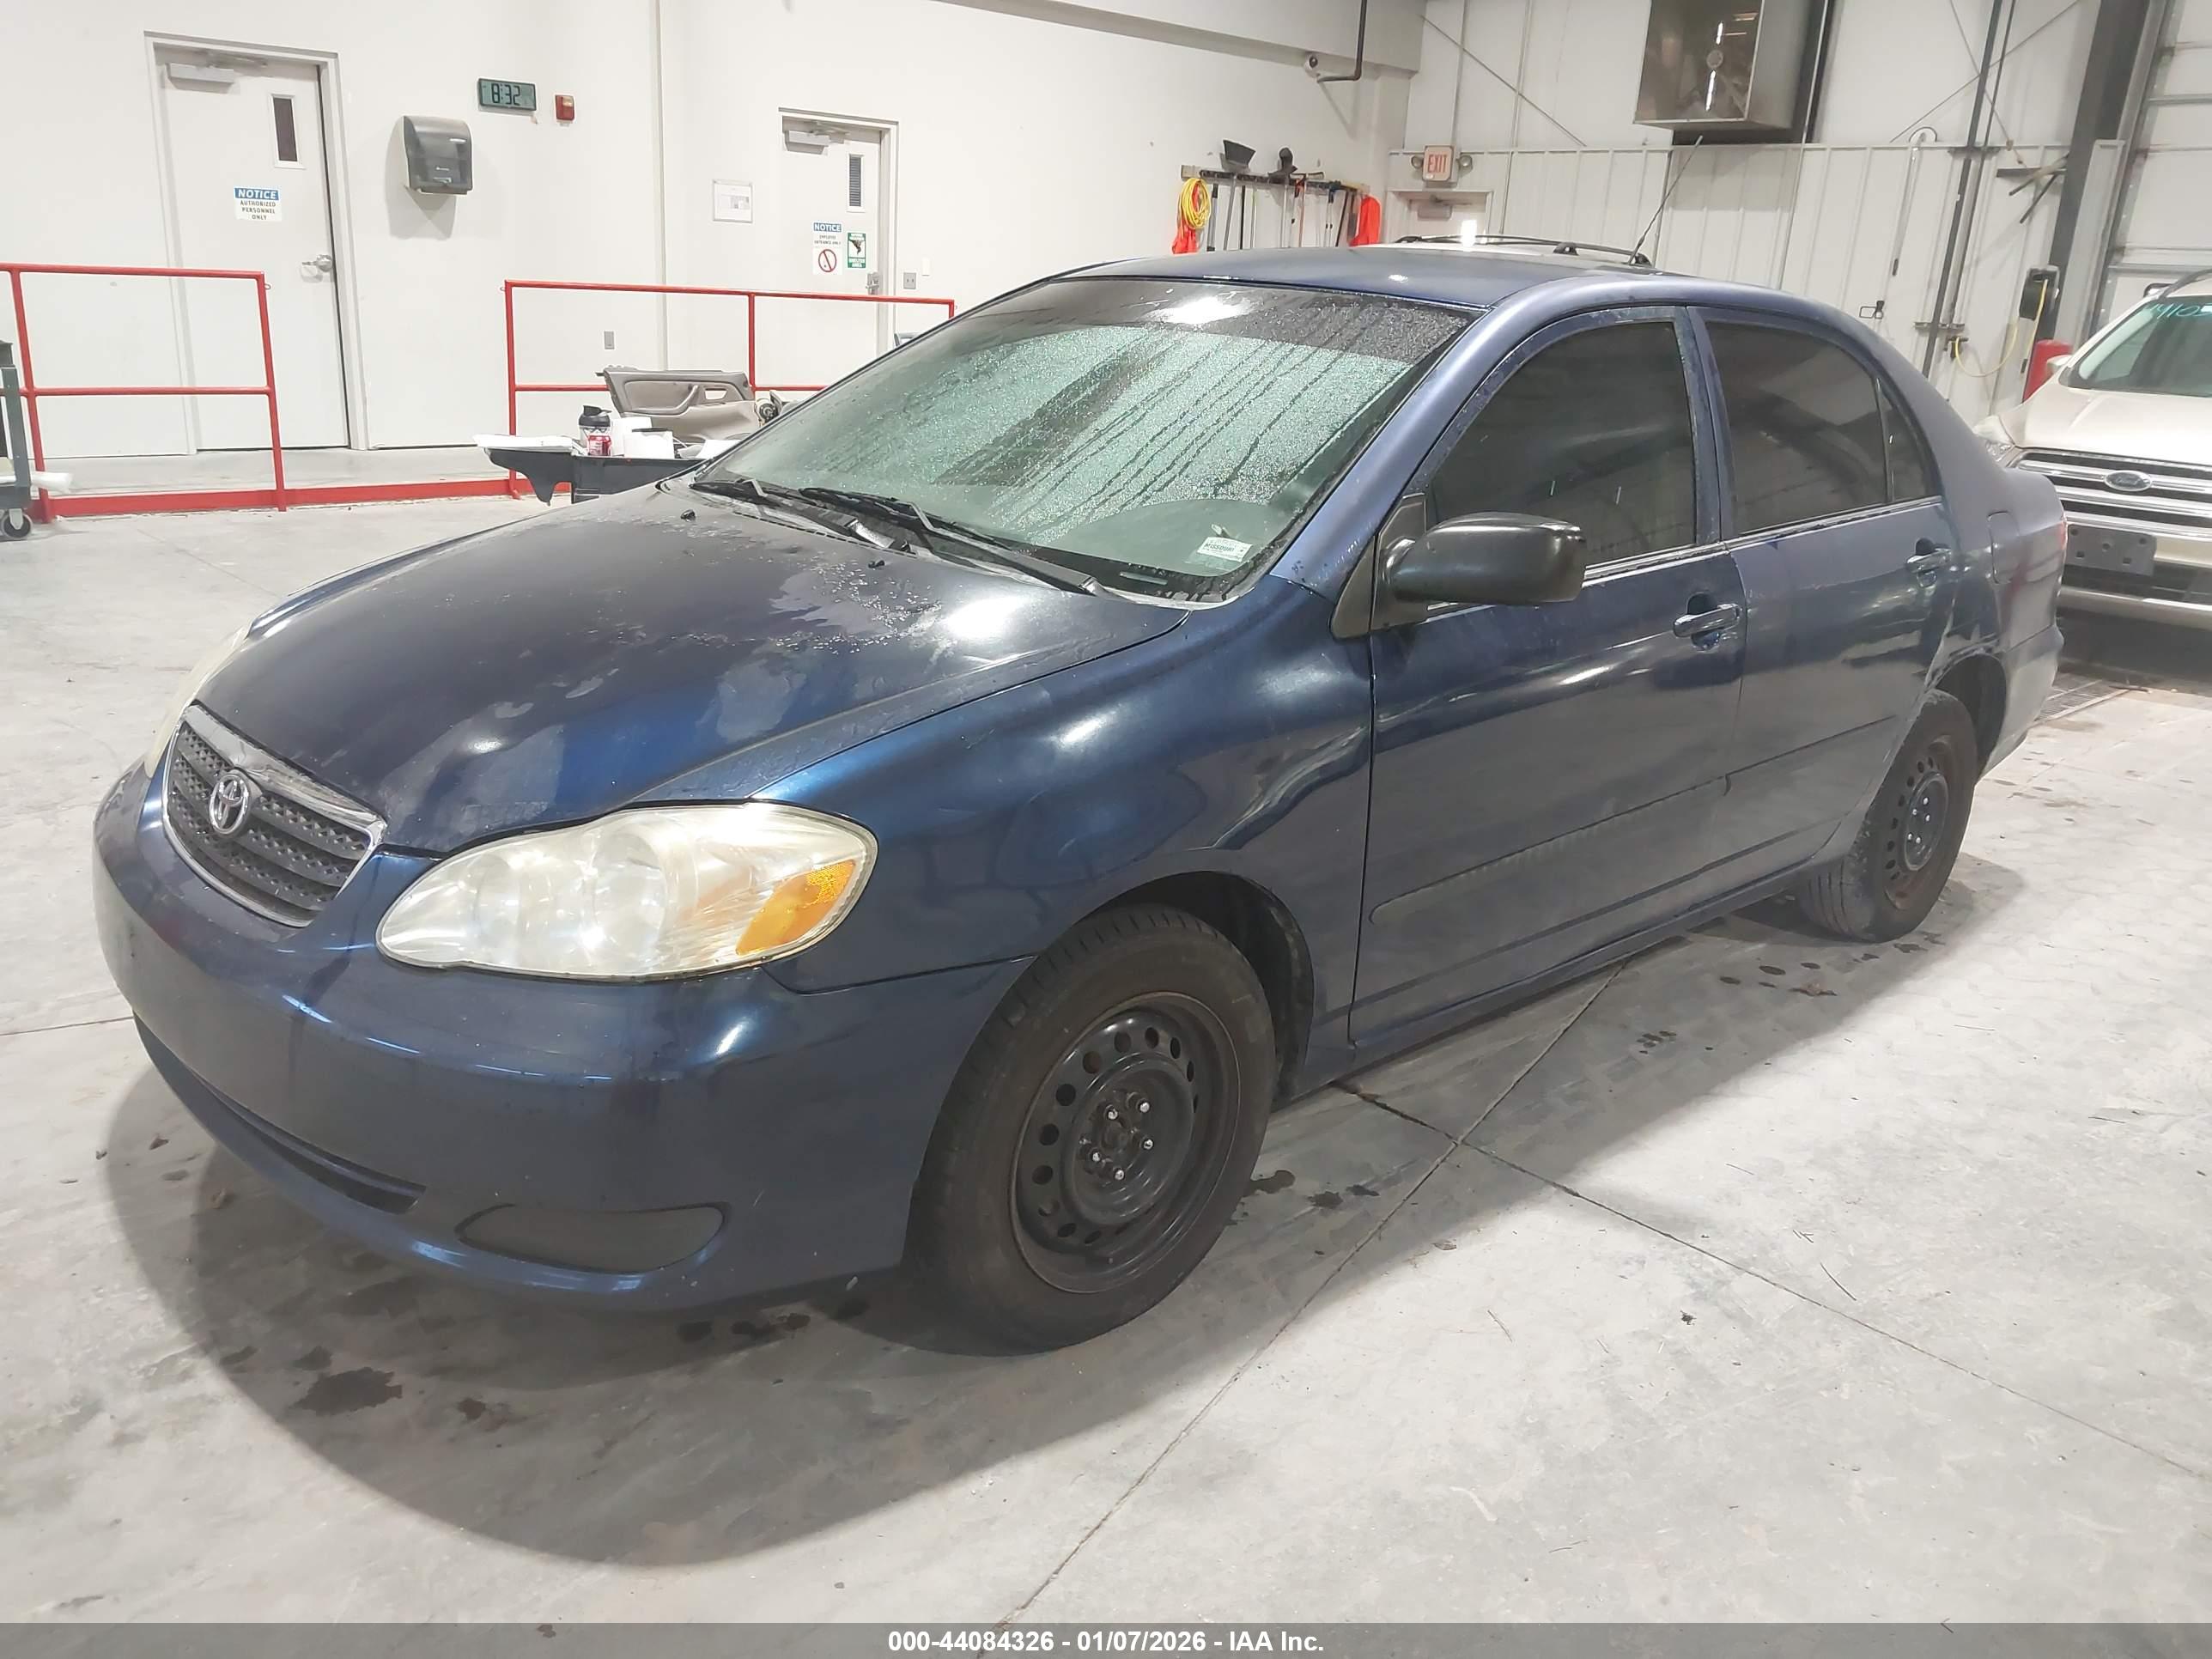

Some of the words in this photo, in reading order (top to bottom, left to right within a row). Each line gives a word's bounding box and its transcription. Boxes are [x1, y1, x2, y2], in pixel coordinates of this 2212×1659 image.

[490, 82, 521, 106] 8:32
[1427, 154, 1448, 173] EXIT
[237, 188, 277, 200] NOTICE
[814, 223, 842, 232] NOTICE
[1204, 543, 1235, 552] MISSOURI
